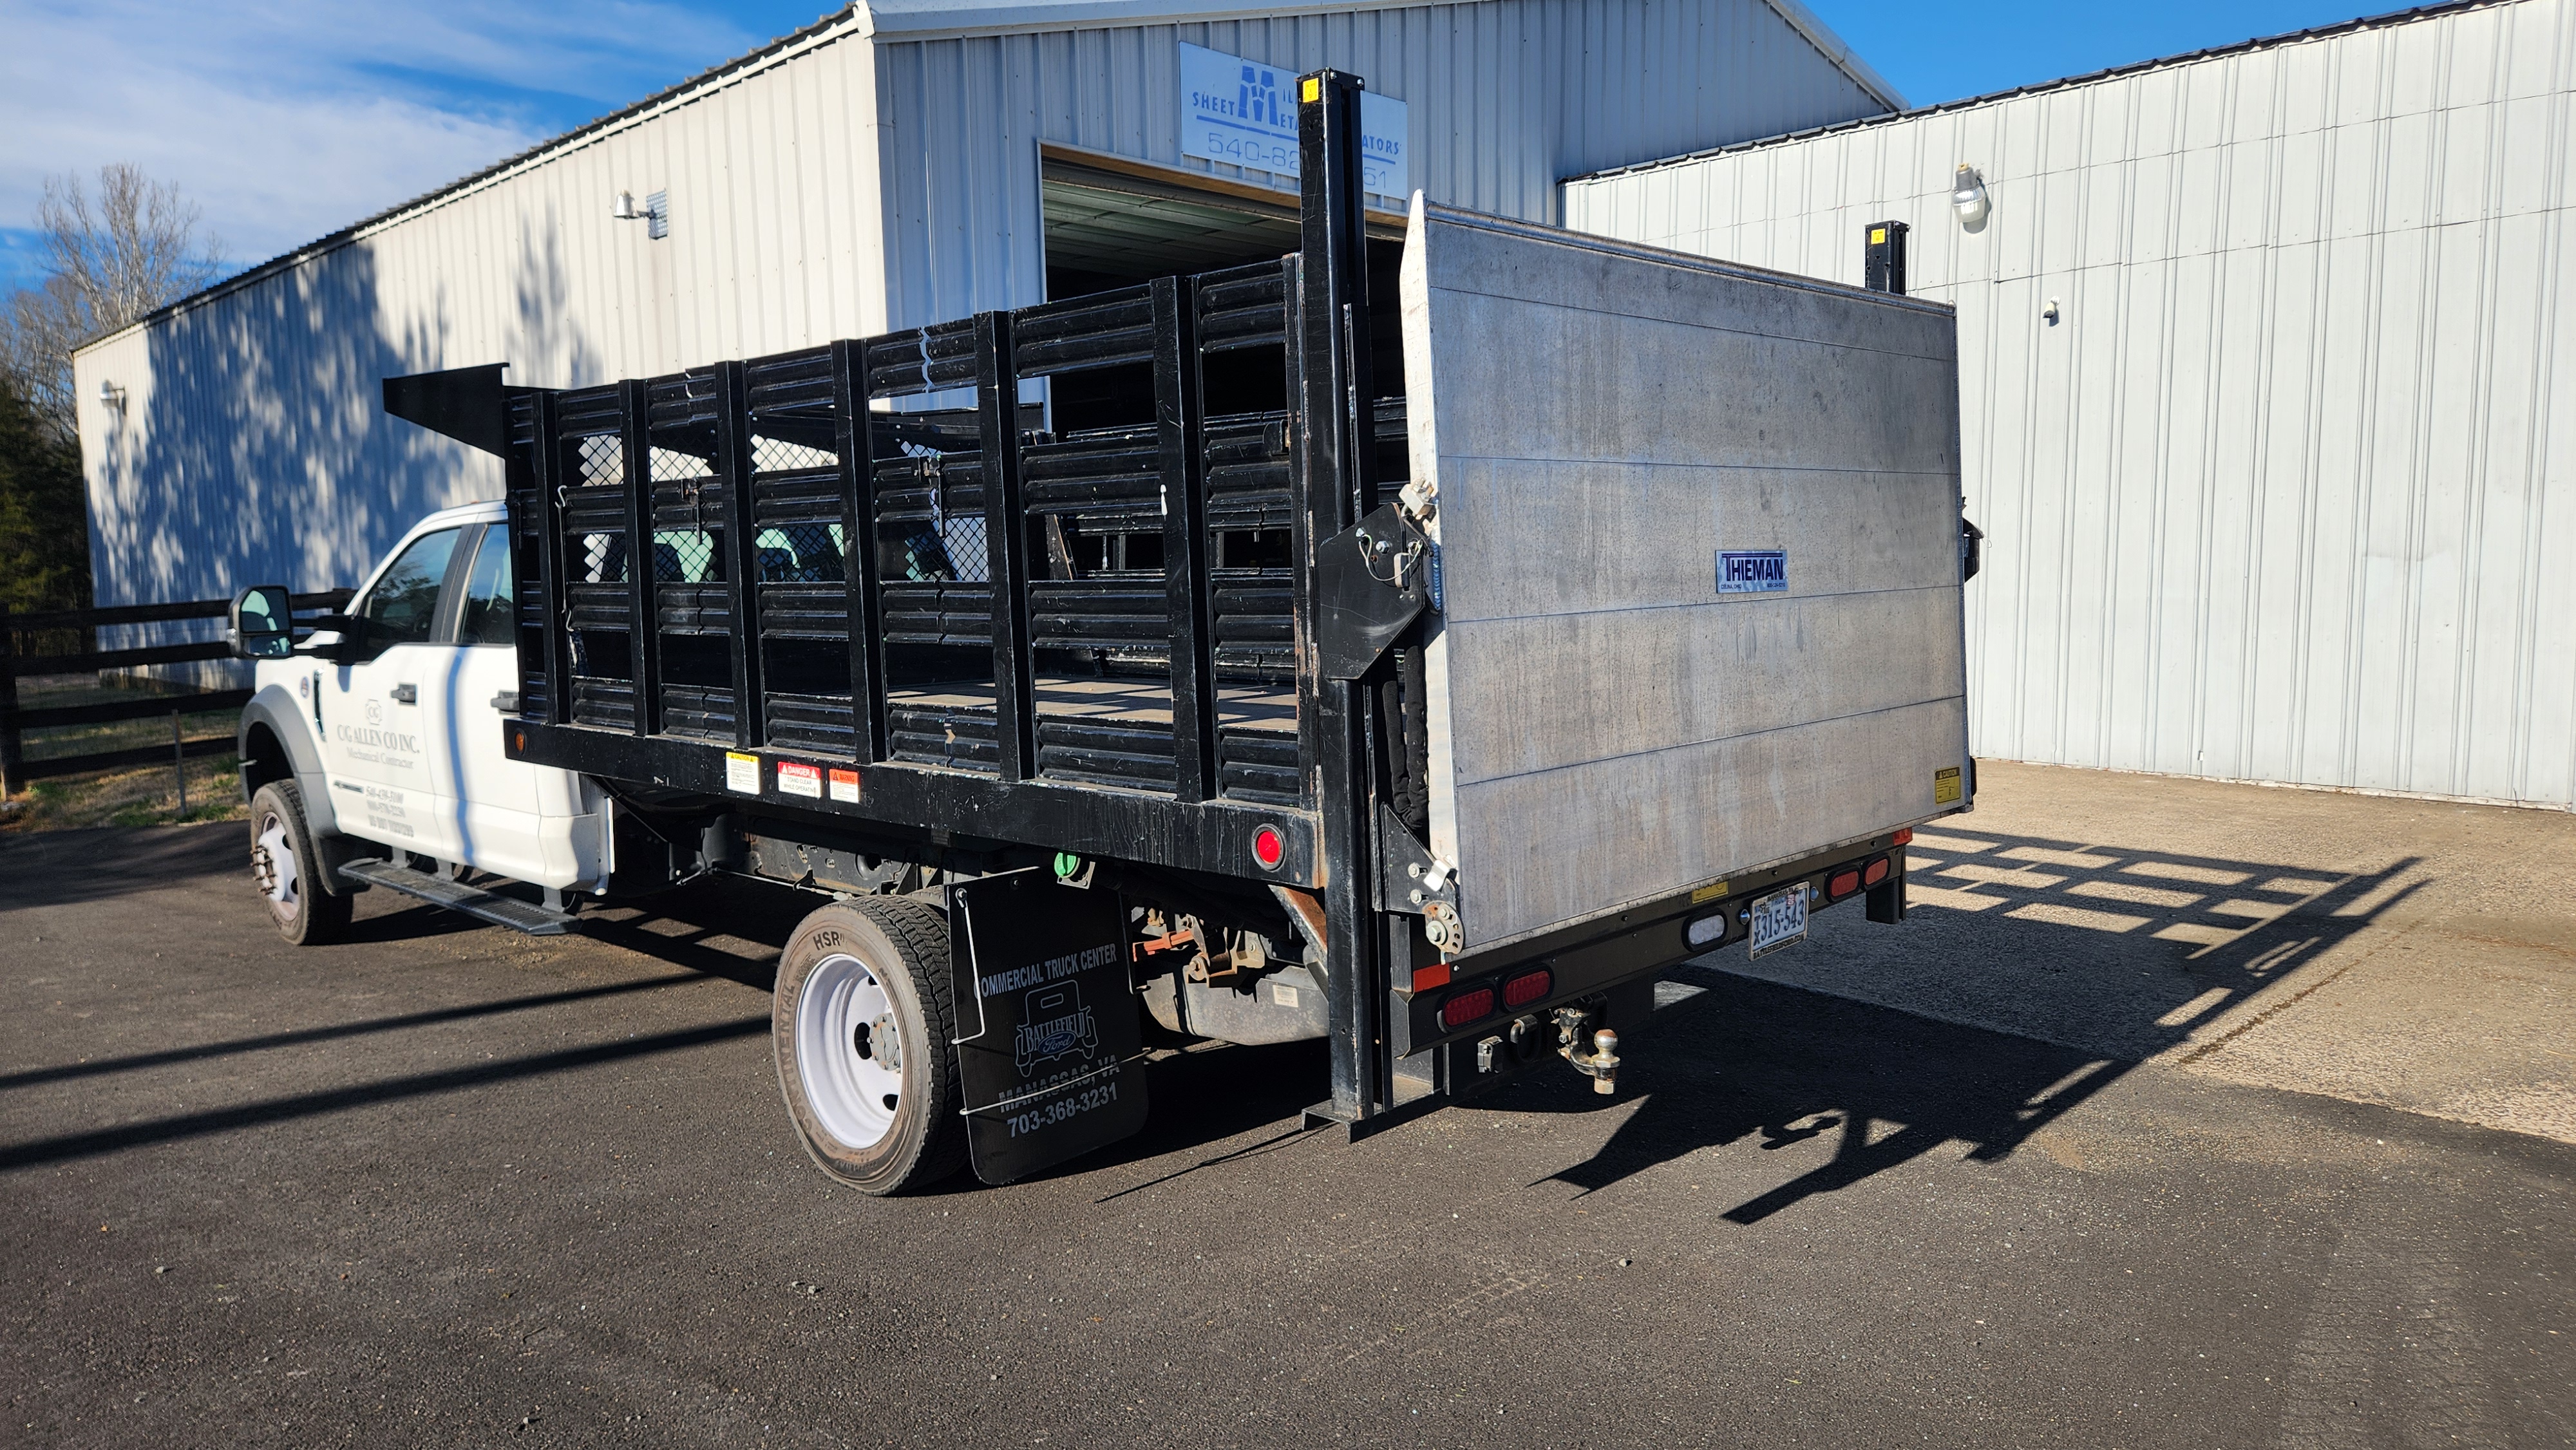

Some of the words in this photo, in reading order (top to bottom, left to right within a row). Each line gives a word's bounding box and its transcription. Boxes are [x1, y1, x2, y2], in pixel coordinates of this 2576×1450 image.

[1193, 91, 1235, 116] SHEET
[1721, 552, 1784, 581] THIEMAN
[354, 728, 382, 748] ALLEN
[383, 731, 397, 750] CO
[788, 766, 810, 777] DANGER
[839, 773, 855, 782] WARNING
[795, 784, 817, 793] OPERATIN
[1045, 952, 1079, 980] TRUCK
[1081, 943, 1117, 971] CENTER
[1023, 1012, 1086, 1056] BATTLEFIELD
[1041, 1034, 1071, 1055] Ford
[1097, 1054, 1121, 1078] VA
[1007, 1082, 1118, 1138] 703-368-3231
